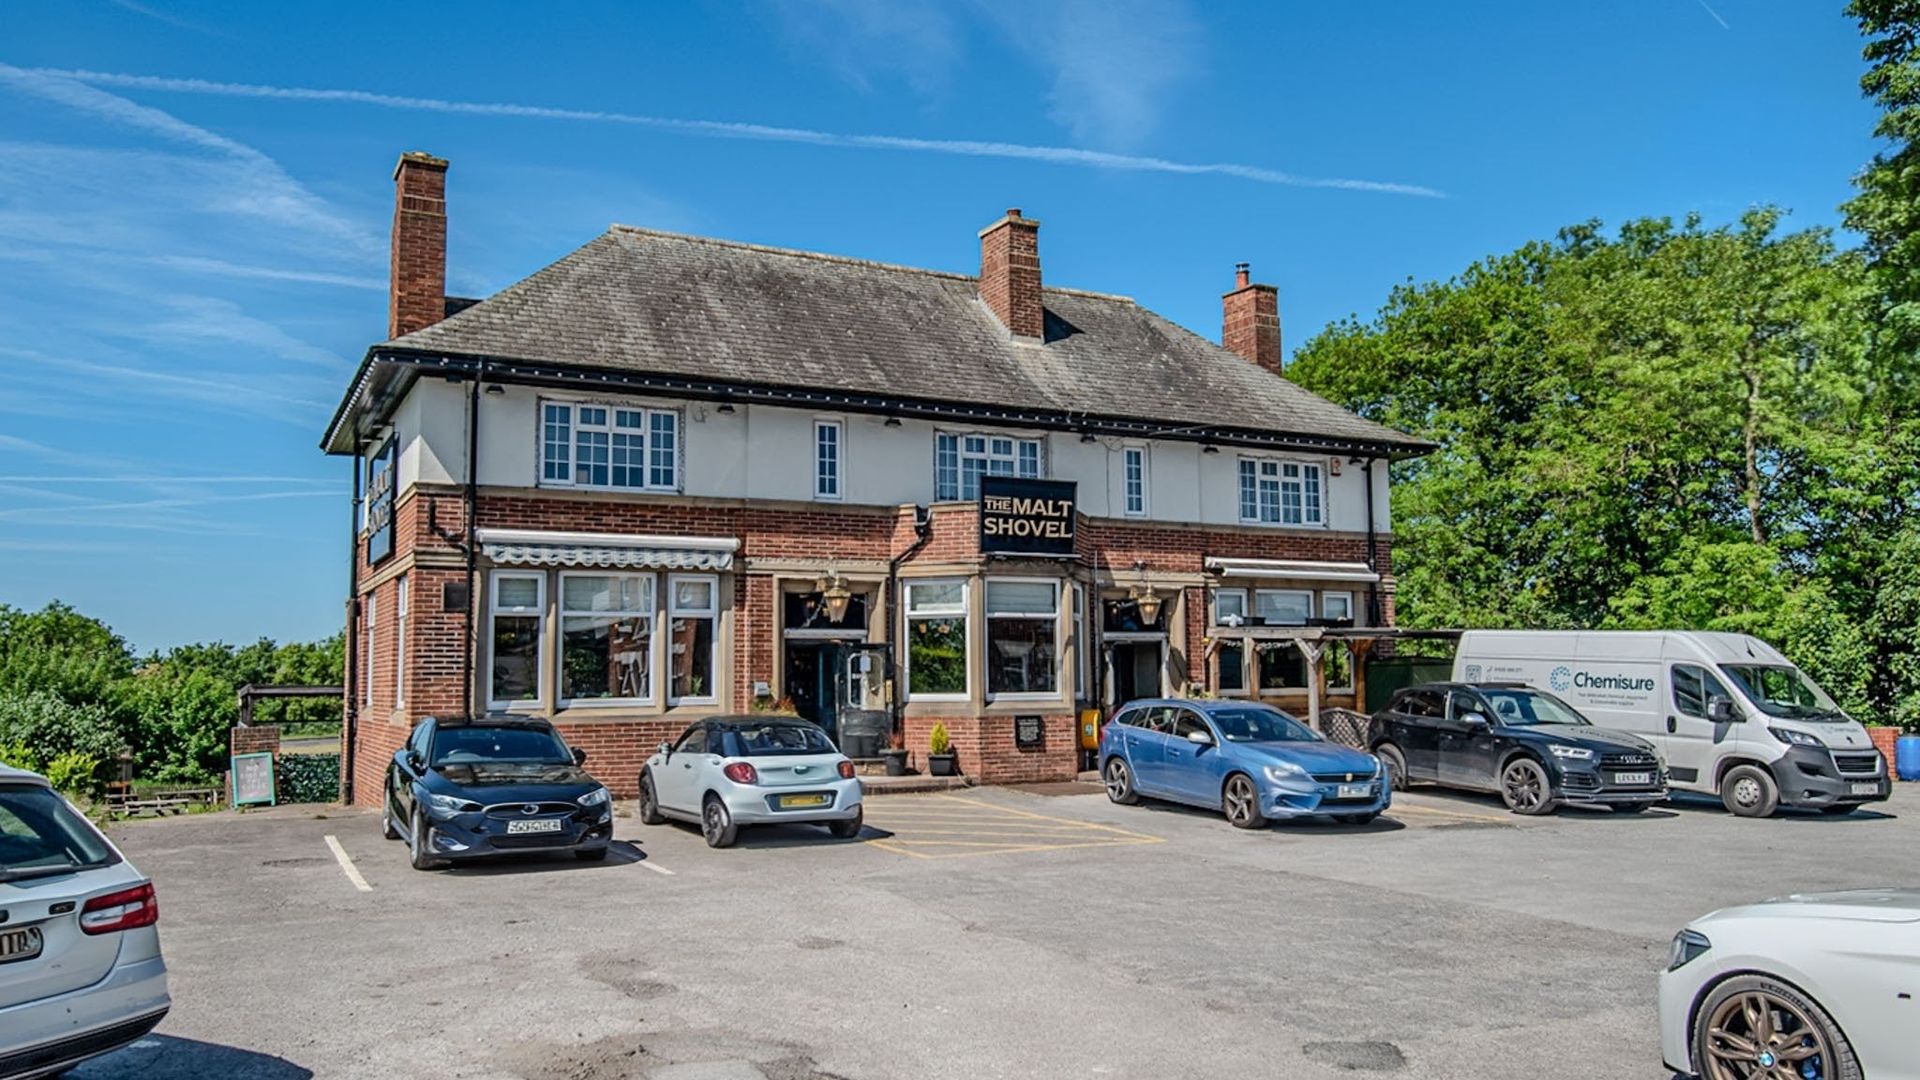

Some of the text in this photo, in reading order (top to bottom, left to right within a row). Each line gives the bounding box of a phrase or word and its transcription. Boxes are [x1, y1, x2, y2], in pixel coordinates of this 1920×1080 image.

[984, 498, 1073, 517] THE MALT
[984, 517, 1073, 538] SHOVEL
[1574, 671, 1655, 691] Chemisure
